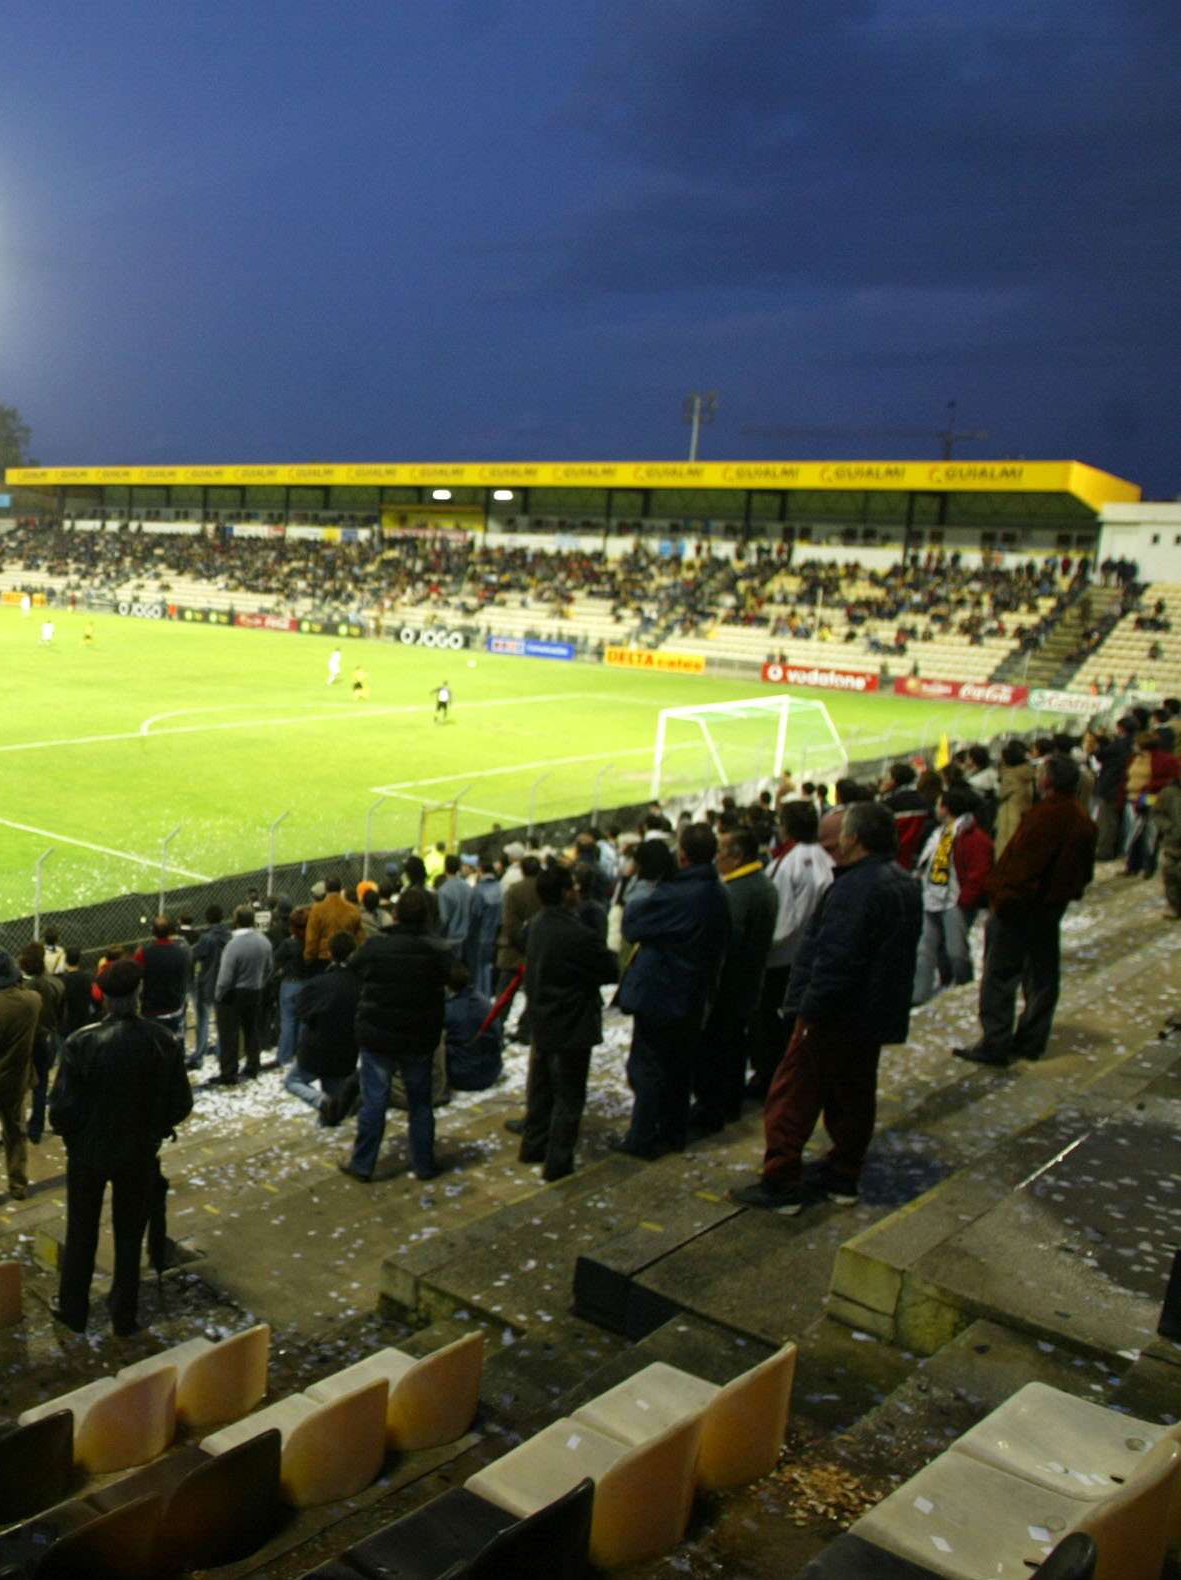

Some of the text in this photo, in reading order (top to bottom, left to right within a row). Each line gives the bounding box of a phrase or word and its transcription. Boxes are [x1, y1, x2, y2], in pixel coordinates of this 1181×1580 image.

[735, 467, 800, 480] GUIALMI
[834, 467, 907, 480] GUIALMI
[945, 467, 1025, 481] GUIALMI
[119, 603, 162, 619] O JOGO
[400, 627, 464, 650] O JOGO
[608, 648, 654, 668] DELTA
[786, 668, 866, 690] vodafone
